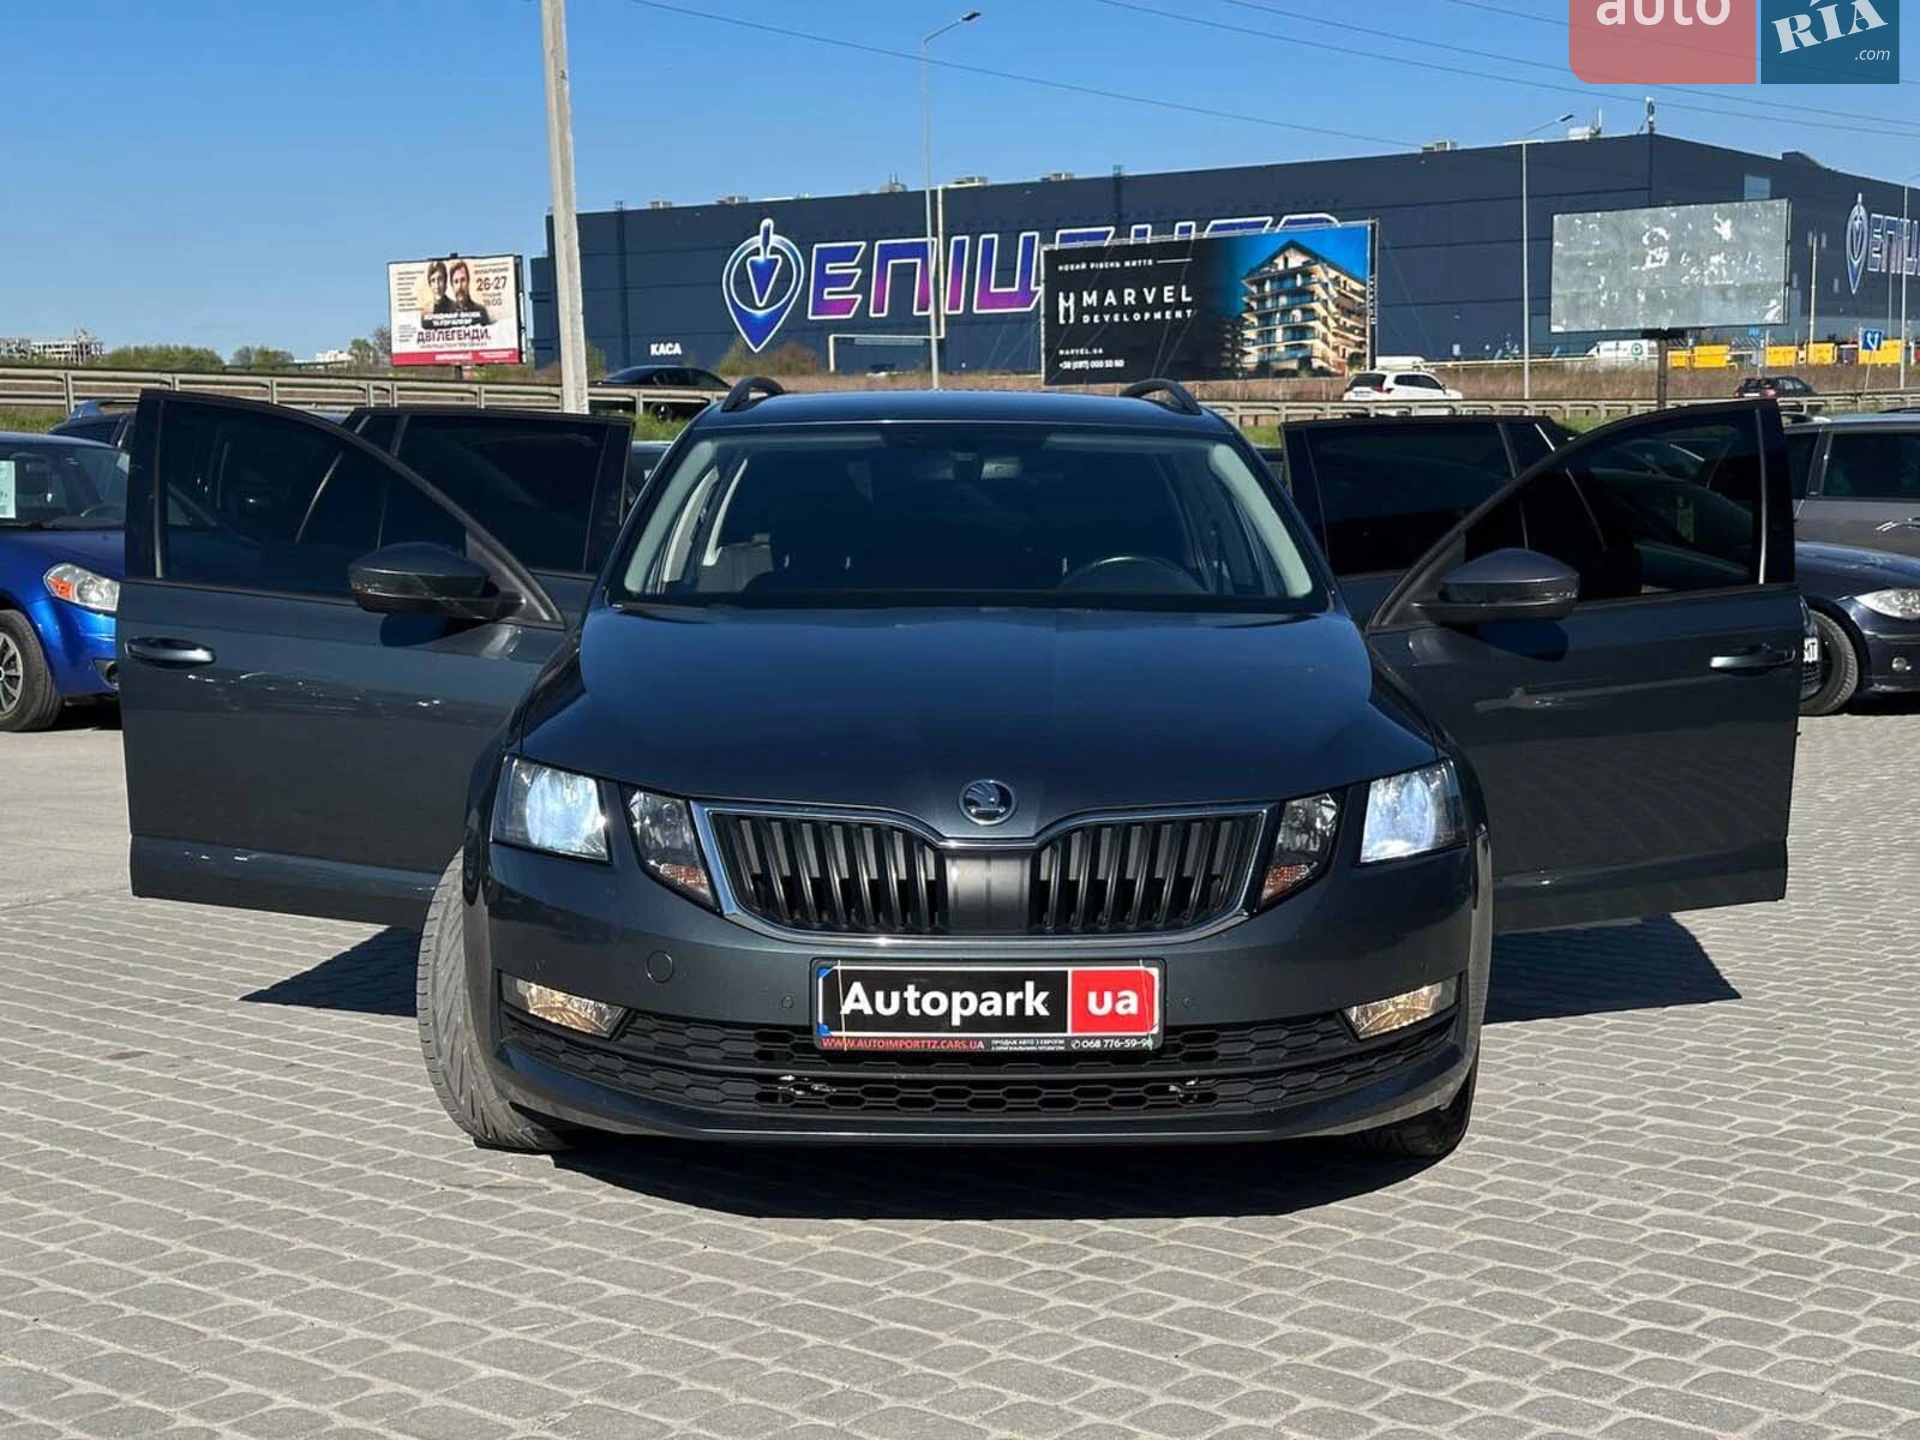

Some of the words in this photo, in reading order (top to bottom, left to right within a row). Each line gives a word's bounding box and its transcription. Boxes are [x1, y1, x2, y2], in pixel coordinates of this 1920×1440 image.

[475, 275, 508, 292] 26-27
[1082, 285, 1192, 306] MARVEL
[1082, 309, 1192, 323] DEVELOPMENT
[649, 341, 683, 356] КАСА
[841, 980, 1050, 1026] Autopark
[1086, 988, 1139, 1016] ua
[1081, 1038, 1102, 1049] 068
